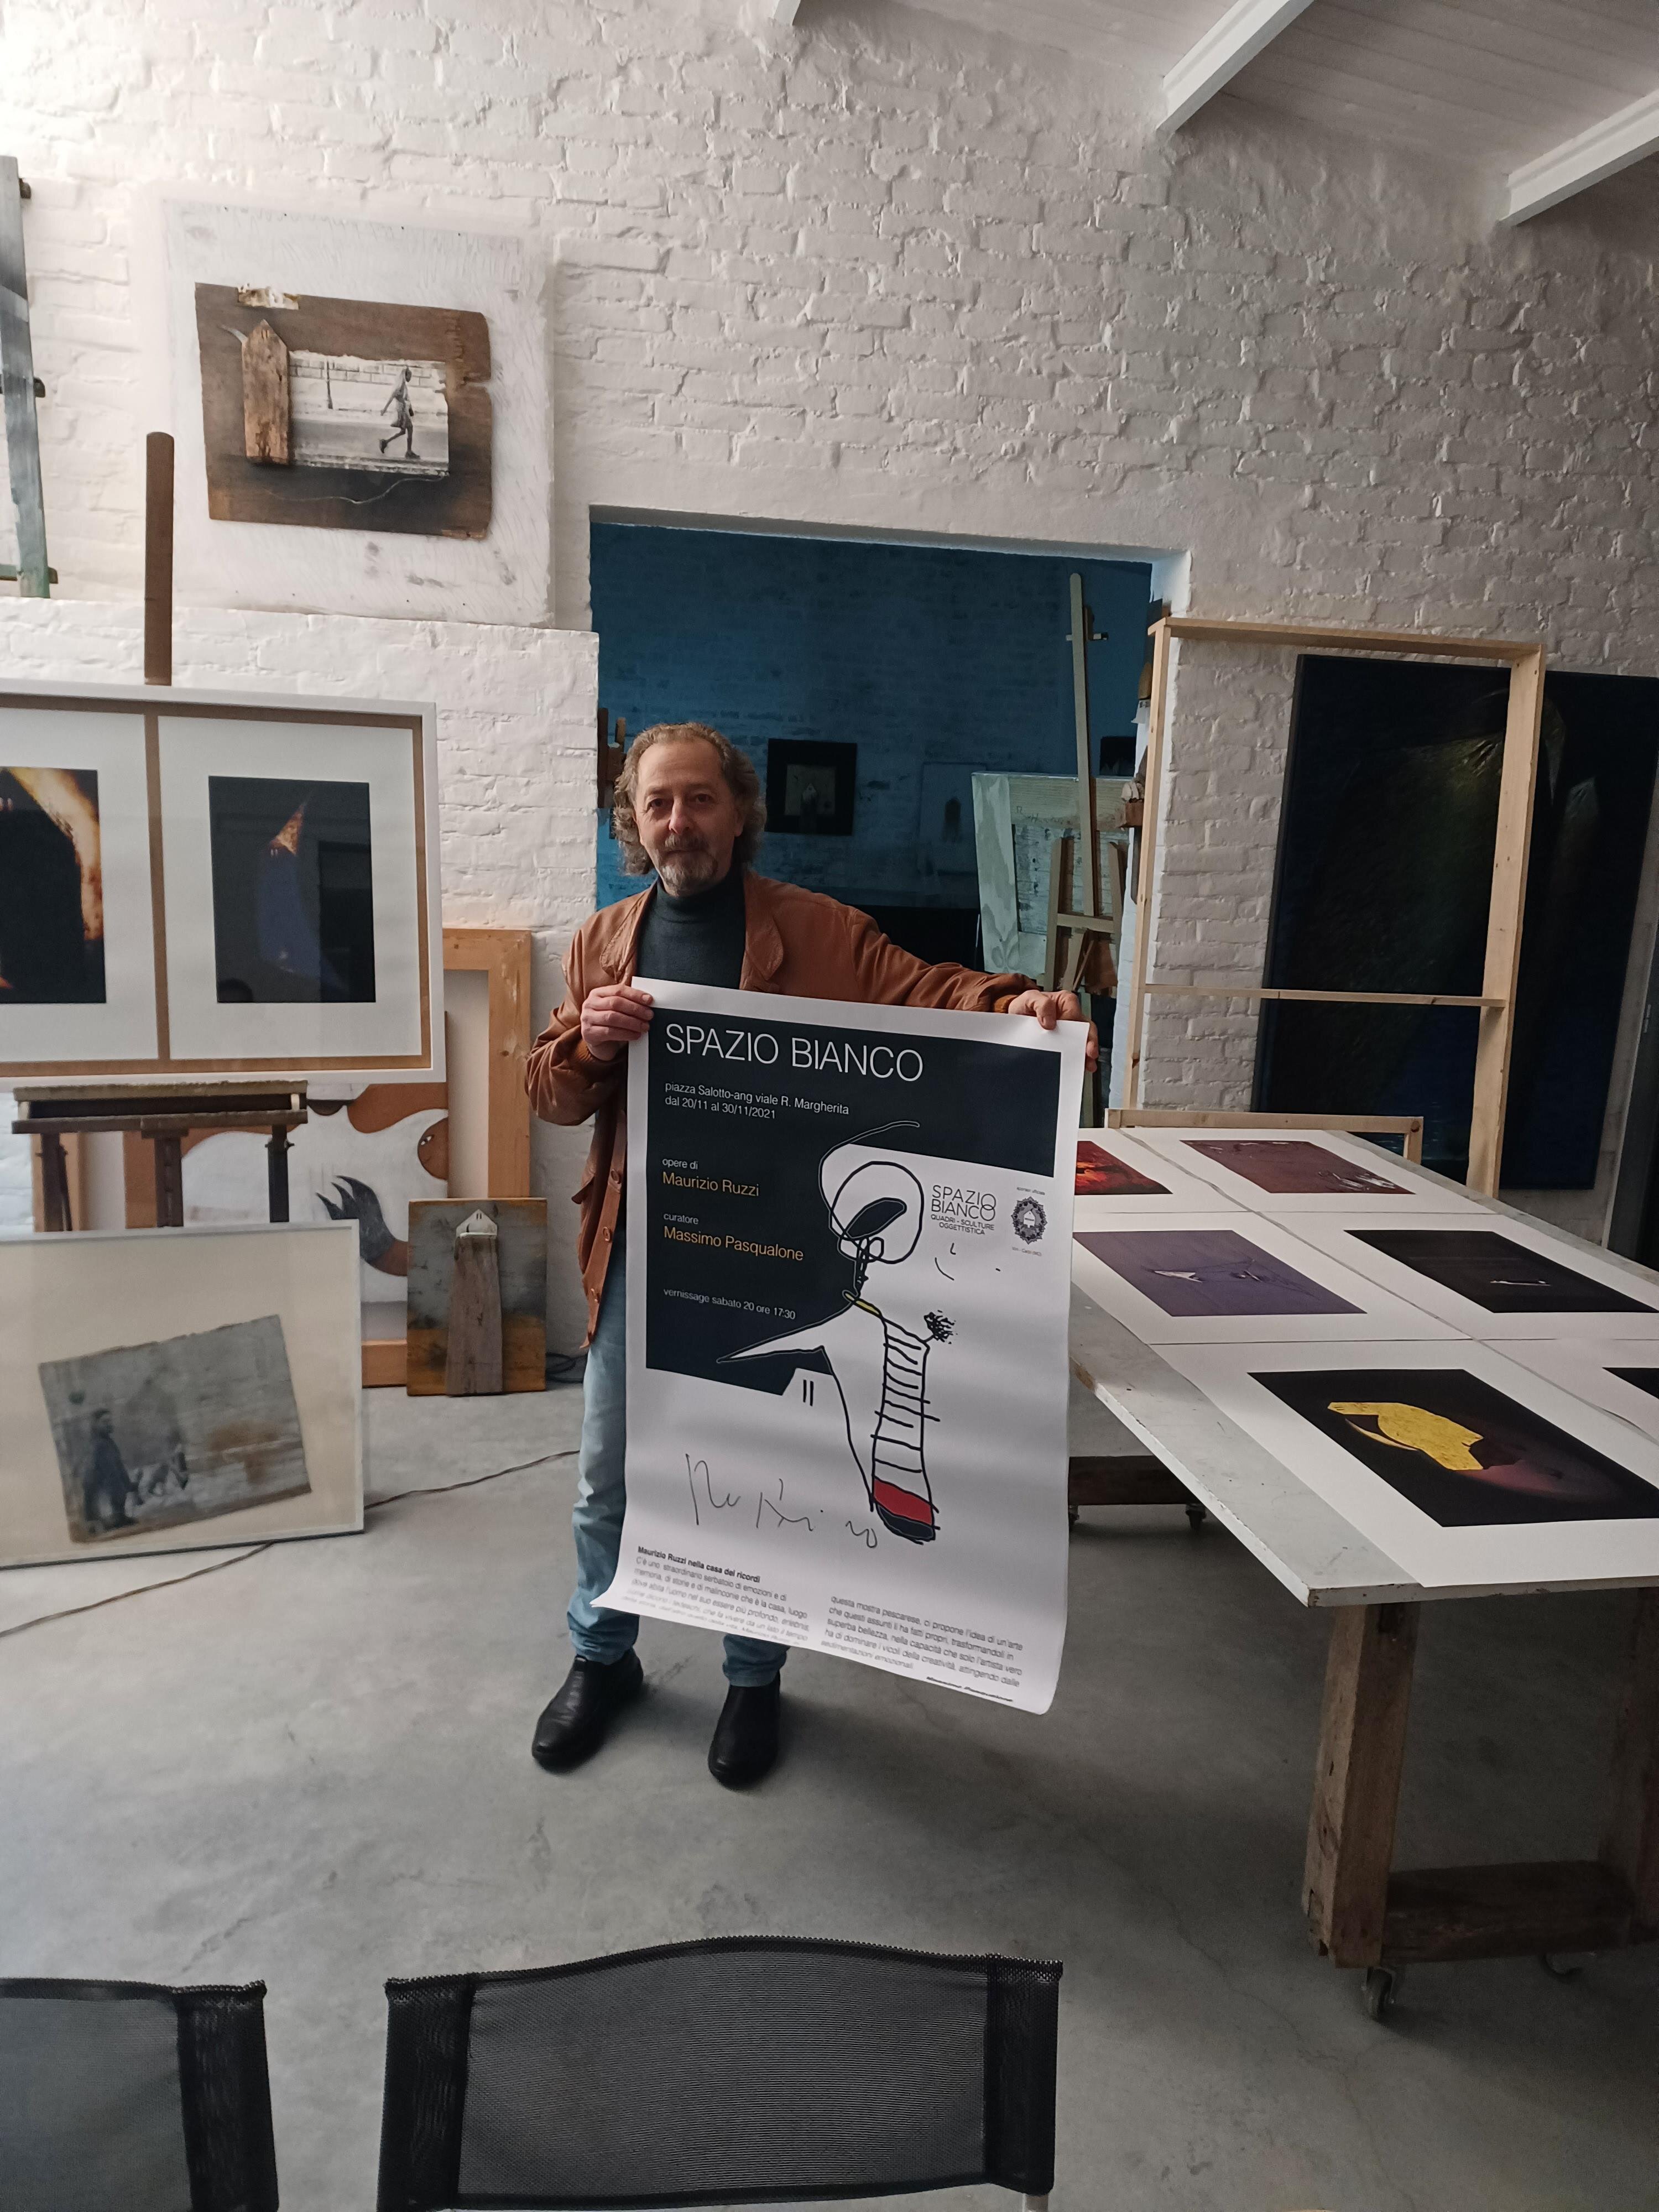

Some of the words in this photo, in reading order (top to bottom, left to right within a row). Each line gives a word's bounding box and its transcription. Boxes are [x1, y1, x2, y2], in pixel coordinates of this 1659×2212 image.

[666, 1023, 779, 1064] SPAZIO
[792, 1037, 923, 1082] BIANCO
[665, 1081, 696, 1094] piazza
[698, 1084, 753, 1104] Salotto-ang
[755, 1093, 778, 1105] viale
[781, 1095, 791, 1107] R.
[794, 1097, 849, 1115] Margherita
[665, 1095, 680, 1106] dal
[682, 1098, 707, 1110] 20/11
[711, 1102, 719, 1112] al
[722, 1103, 775, 1119] 30/11/2021
[662, 1159, 688, 1168] opere
[690, 1161, 698, 1170] di
[662, 1171, 718, 1191] Maurizio
[722, 1179, 759, 1197] Ruzzi
[931, 1185, 997, 1211] SPAZIO
[931, 1198, 995, 1222] BIANCO
[664, 1213, 699, 1225] curatore
[931, 1214, 956, 1224] QUADRI
[961, 1219, 995, 1230] SCULTURE
[939, 1222, 985, 1235] OGGETTISTICA
[664, 1225, 722, 1247] Massimo
[725, 1235, 804, 1261] Pasqualone
[664, 1288, 709, 1303] vernissage
[712, 1297, 742, 1308] sabato
[743, 1301, 755, 1311] 20
[756, 1305, 770, 1314] ore
[774, 1307, 796, 1320] 17:30
[638, 1546, 666, 1559] Maurizio
[667, 1553, 687, 1564] Ruzzi
[688, 1559, 705, 1569] nella
[706, 1564, 723, 1573] casa
[737, 1571, 760, 1583] ricordi
[648, 1561, 660, 1569] uno
[743, 1584, 773, 1598] emozioni
[780, 1593, 787, 1601] di
[740, 1594, 753, 1604] che
[761, 1599, 766, 1608] la
[788, 1606, 808, 1619] luogo
[831, 1596, 855, 1608] questa
[857, 1603, 880, 1614] mostra
[932, 1621, 964, 1636] propone
[829, 1607, 842, 1616] che
[843, 1611, 865, 1622] questi
[867, 1616, 892, 1629] assunti
[899, 1624, 909, 1633] ha
[827, 1618, 856, 1631] superba
[891, 1635, 908, 1645] nella
[943, 1648, 957, 1658] che
[959, 1653, 975, 1663] solo
[1005, 1666, 1022, 1676] vero
